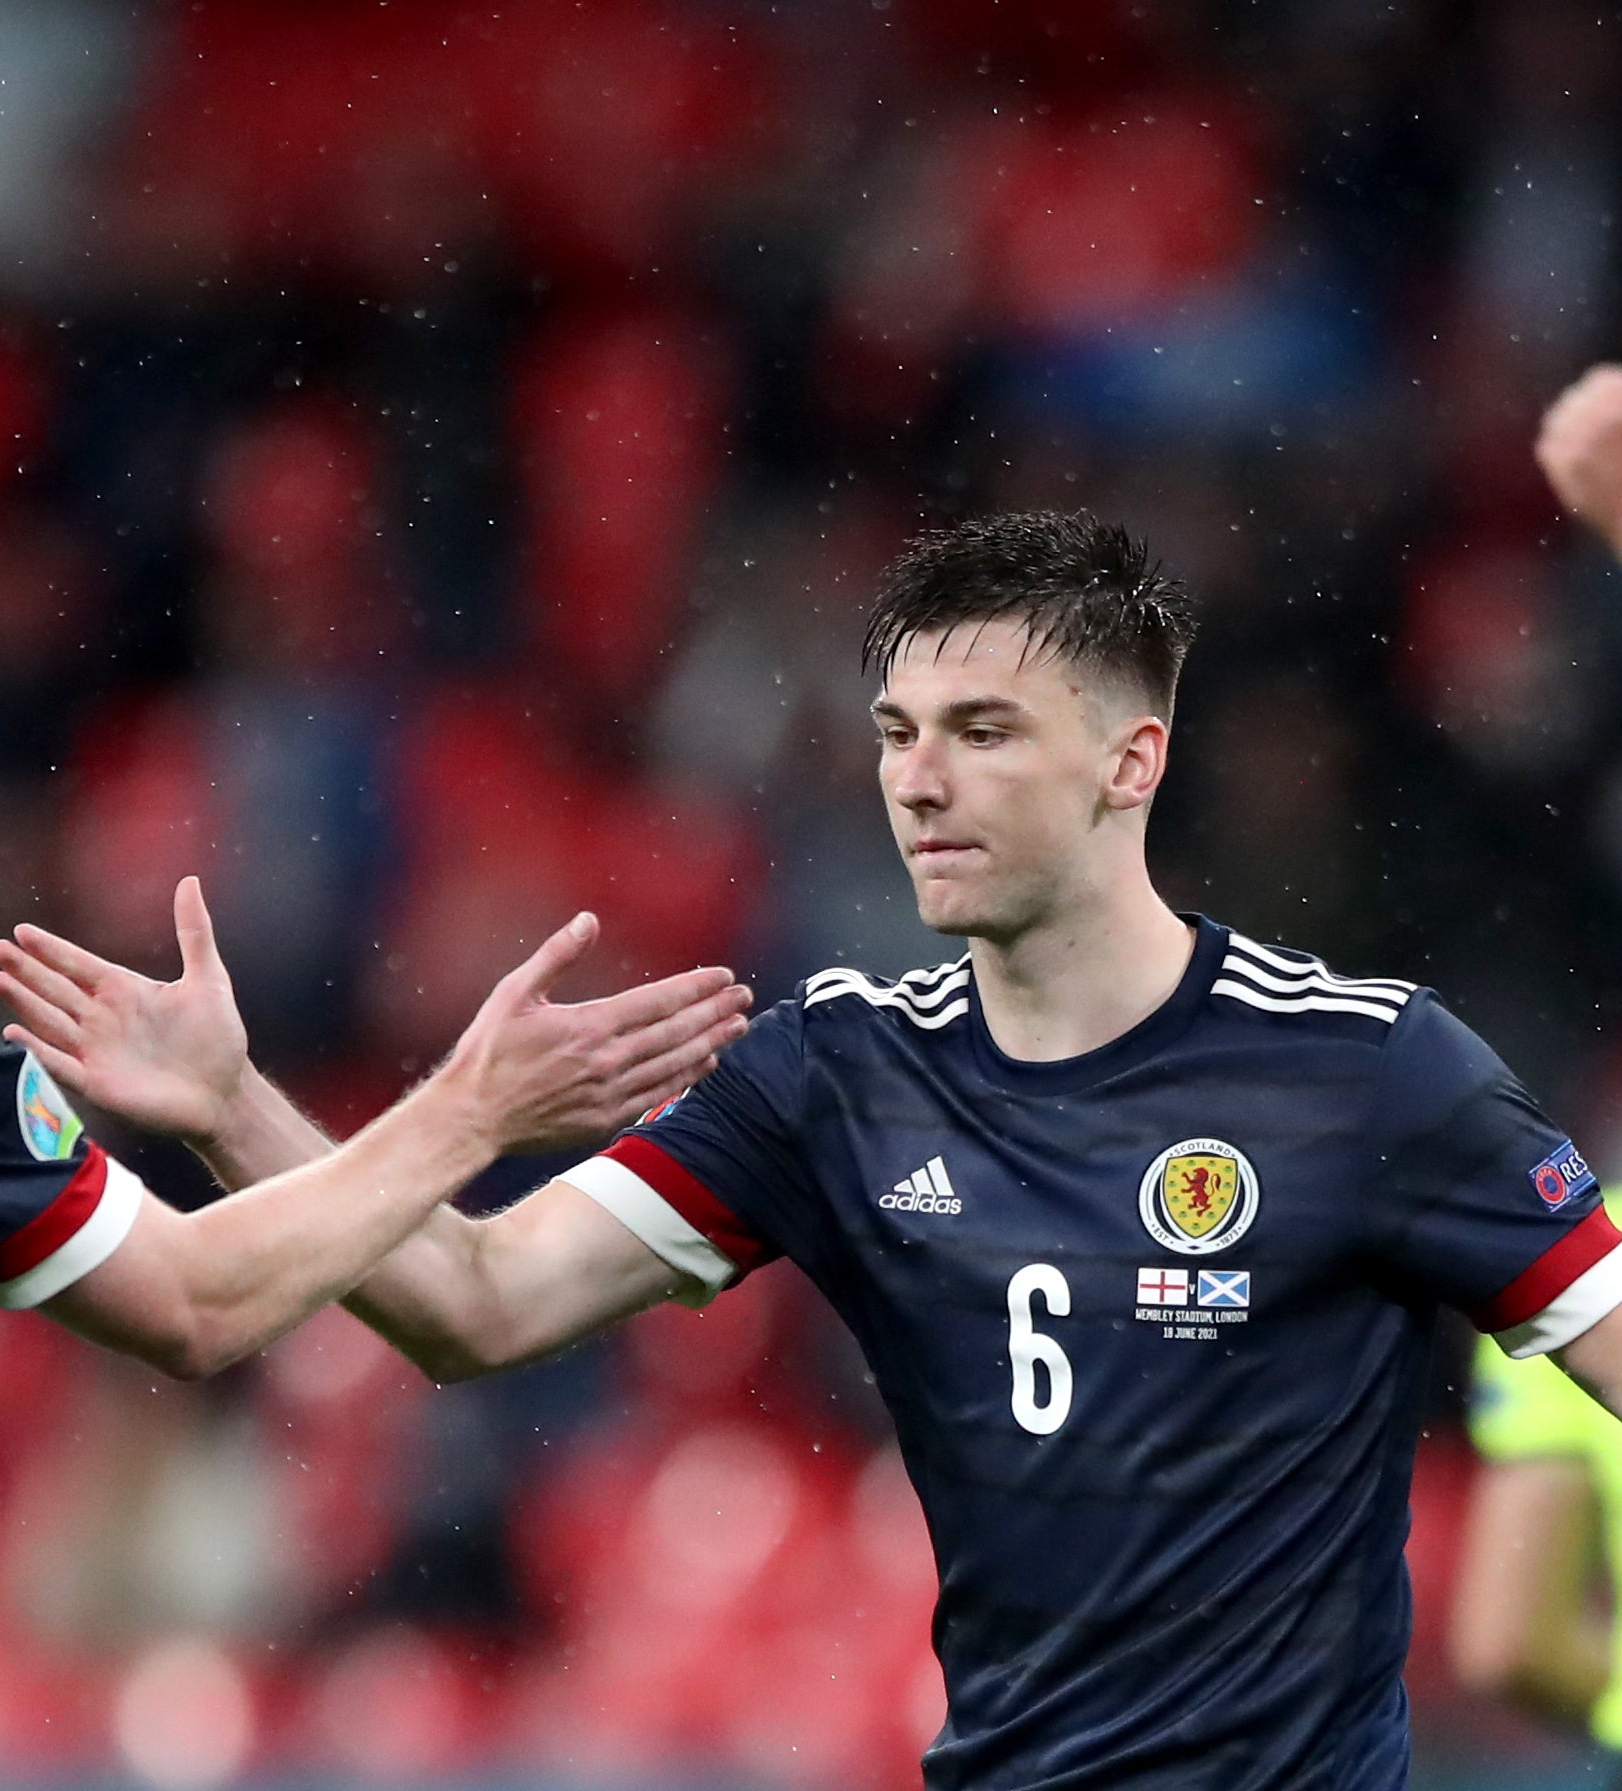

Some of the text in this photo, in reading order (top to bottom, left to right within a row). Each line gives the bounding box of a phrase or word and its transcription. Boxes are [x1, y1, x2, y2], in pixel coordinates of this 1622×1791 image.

[1174, 1142, 1231, 1156] SCOTLAND
[879, 1192, 962, 1214] adidas
[1135, 1308, 1173, 1322] WEMBLEY
[1215, 1311, 1248, 1323] LONDON
[1175, 1327, 1196, 1339] JUNE
[1198, 1328, 1218, 1340] 2021
[1008, 1262, 1072, 1435] 6
